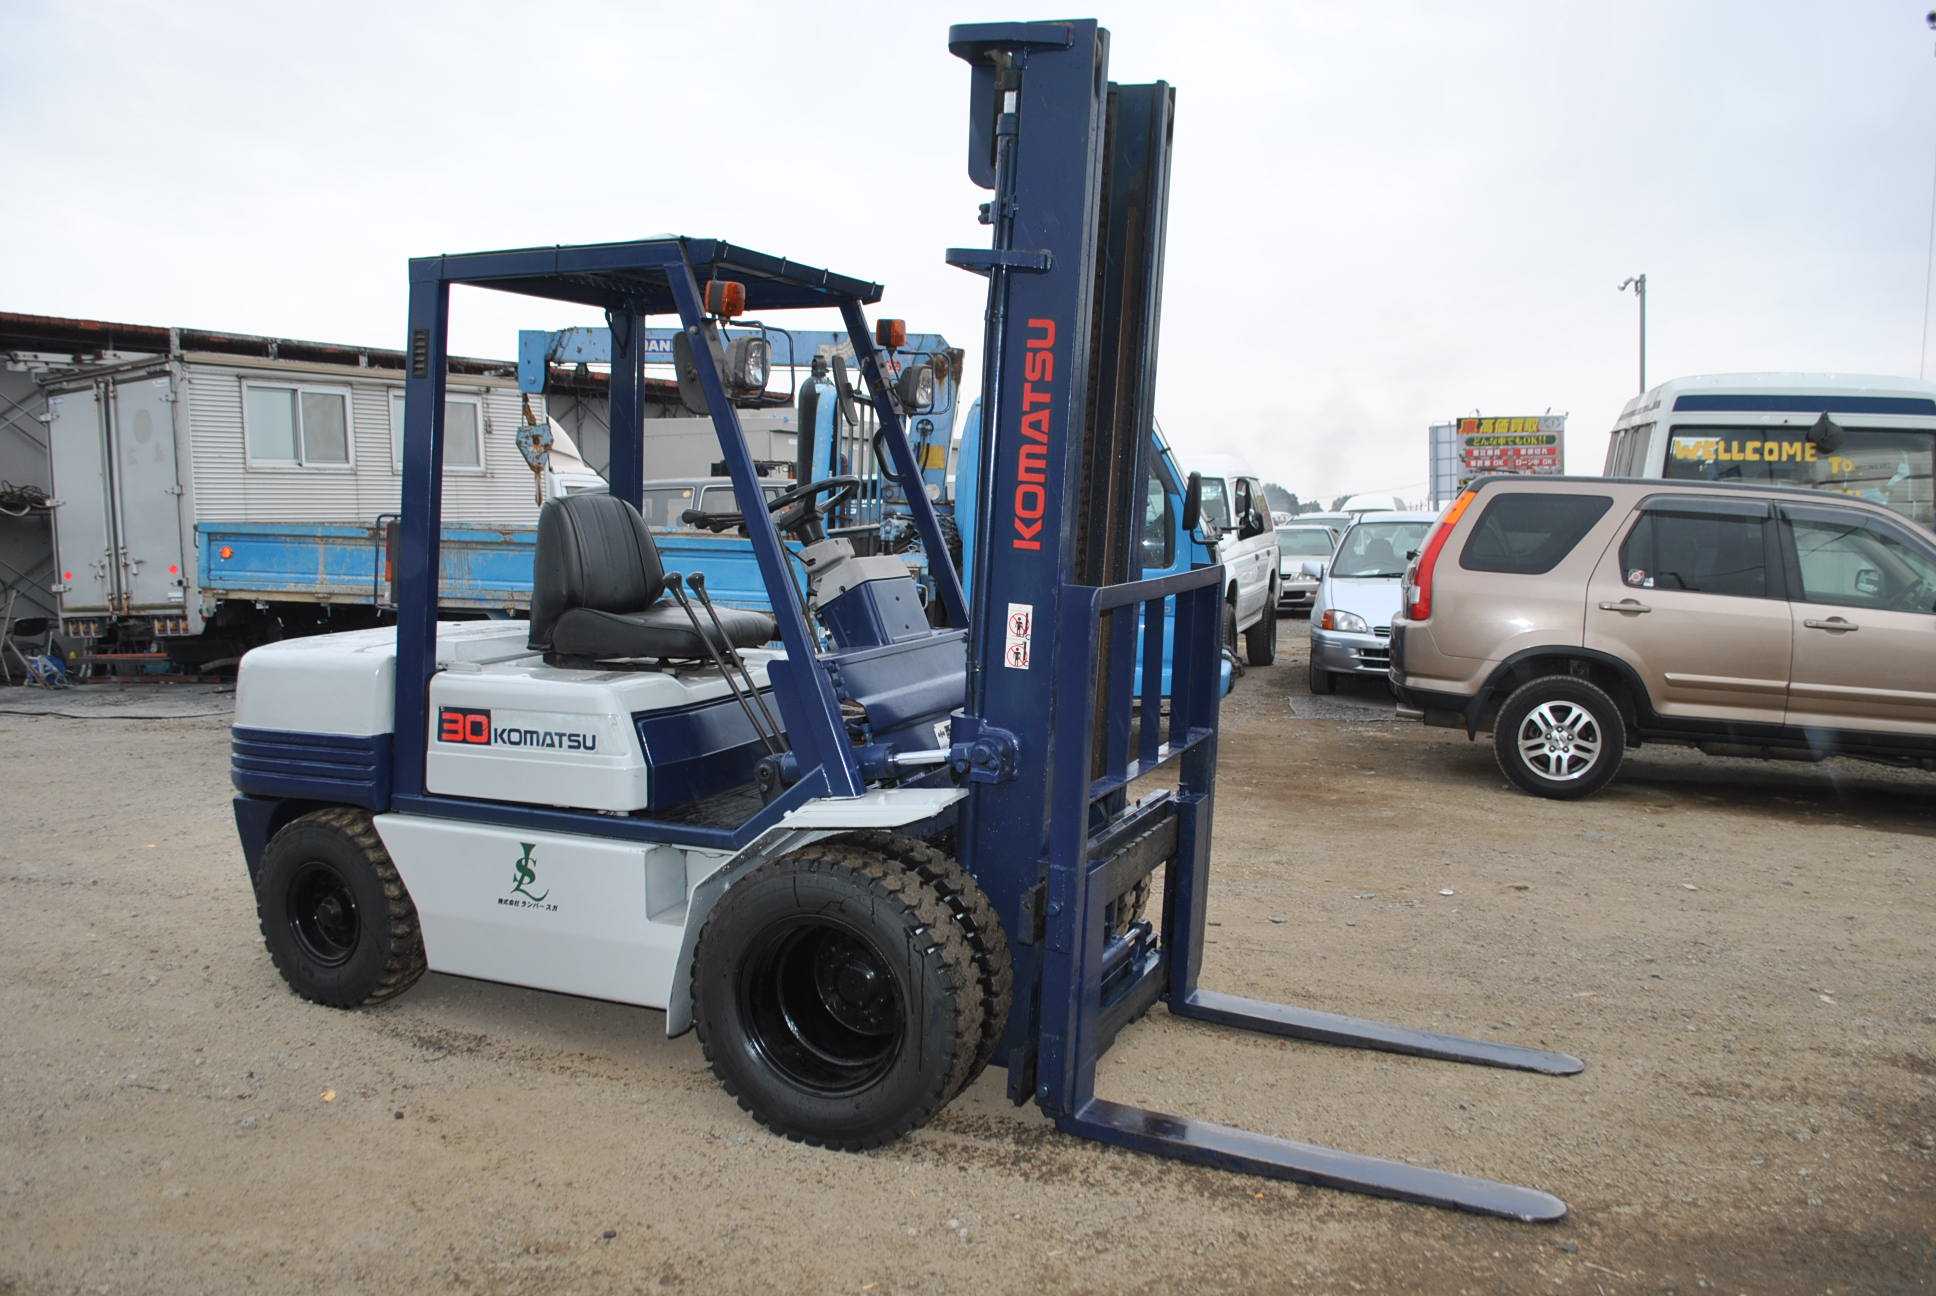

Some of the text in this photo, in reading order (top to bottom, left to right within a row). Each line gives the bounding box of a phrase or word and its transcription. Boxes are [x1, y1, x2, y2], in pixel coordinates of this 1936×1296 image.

[1012, 318, 1056, 550] KOMATSU
[1674, 440, 1818, 462] WELLCOME
[441, 712, 597, 751] 30 KOMATSU
